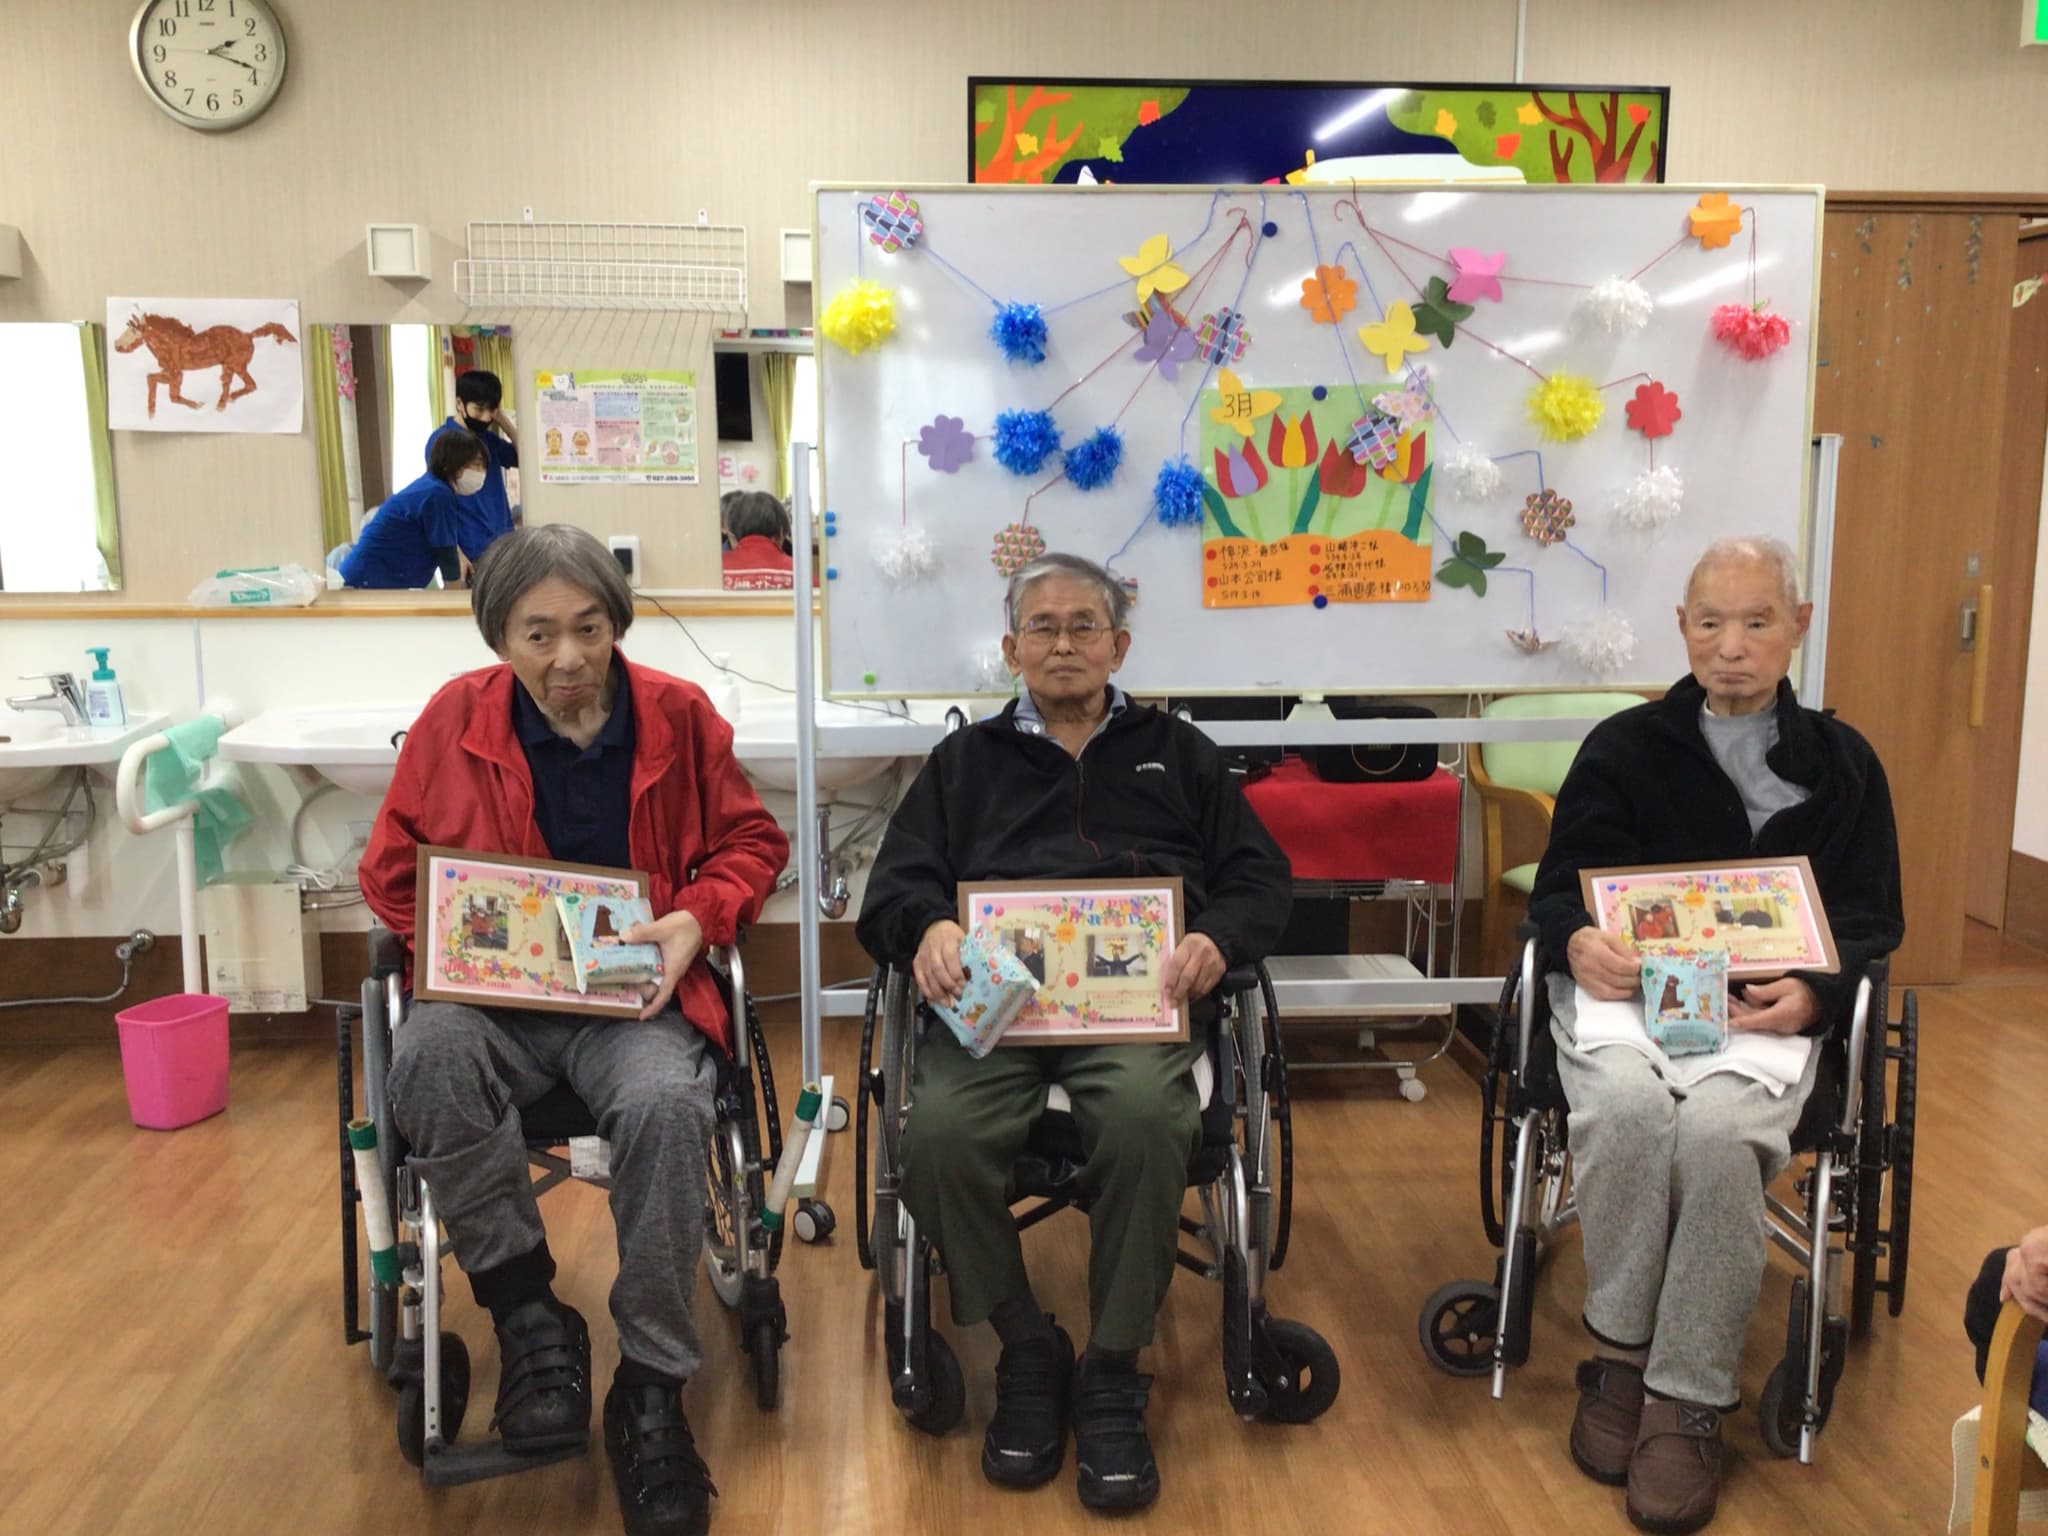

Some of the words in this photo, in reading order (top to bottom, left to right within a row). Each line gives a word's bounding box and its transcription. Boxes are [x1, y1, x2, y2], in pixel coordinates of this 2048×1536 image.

[175, 0, 190, 18] 11
[198, 0, 215, 12] 12
[228, 0, 235, 18] 1
[159, 18, 177, 37] 10
[244, 17, 257, 37] 2
[153, 44, 167, 64] 9
[254, 43, 267, 63] 3
[164, 70, 177, 88] 8
[247, 67, 258, 87] 4
[183, 88, 195, 106] 7
[206, 93, 220, 112] 6
[231, 89, 244, 107] 5
[1223, 391, 1253, 418] 3月
